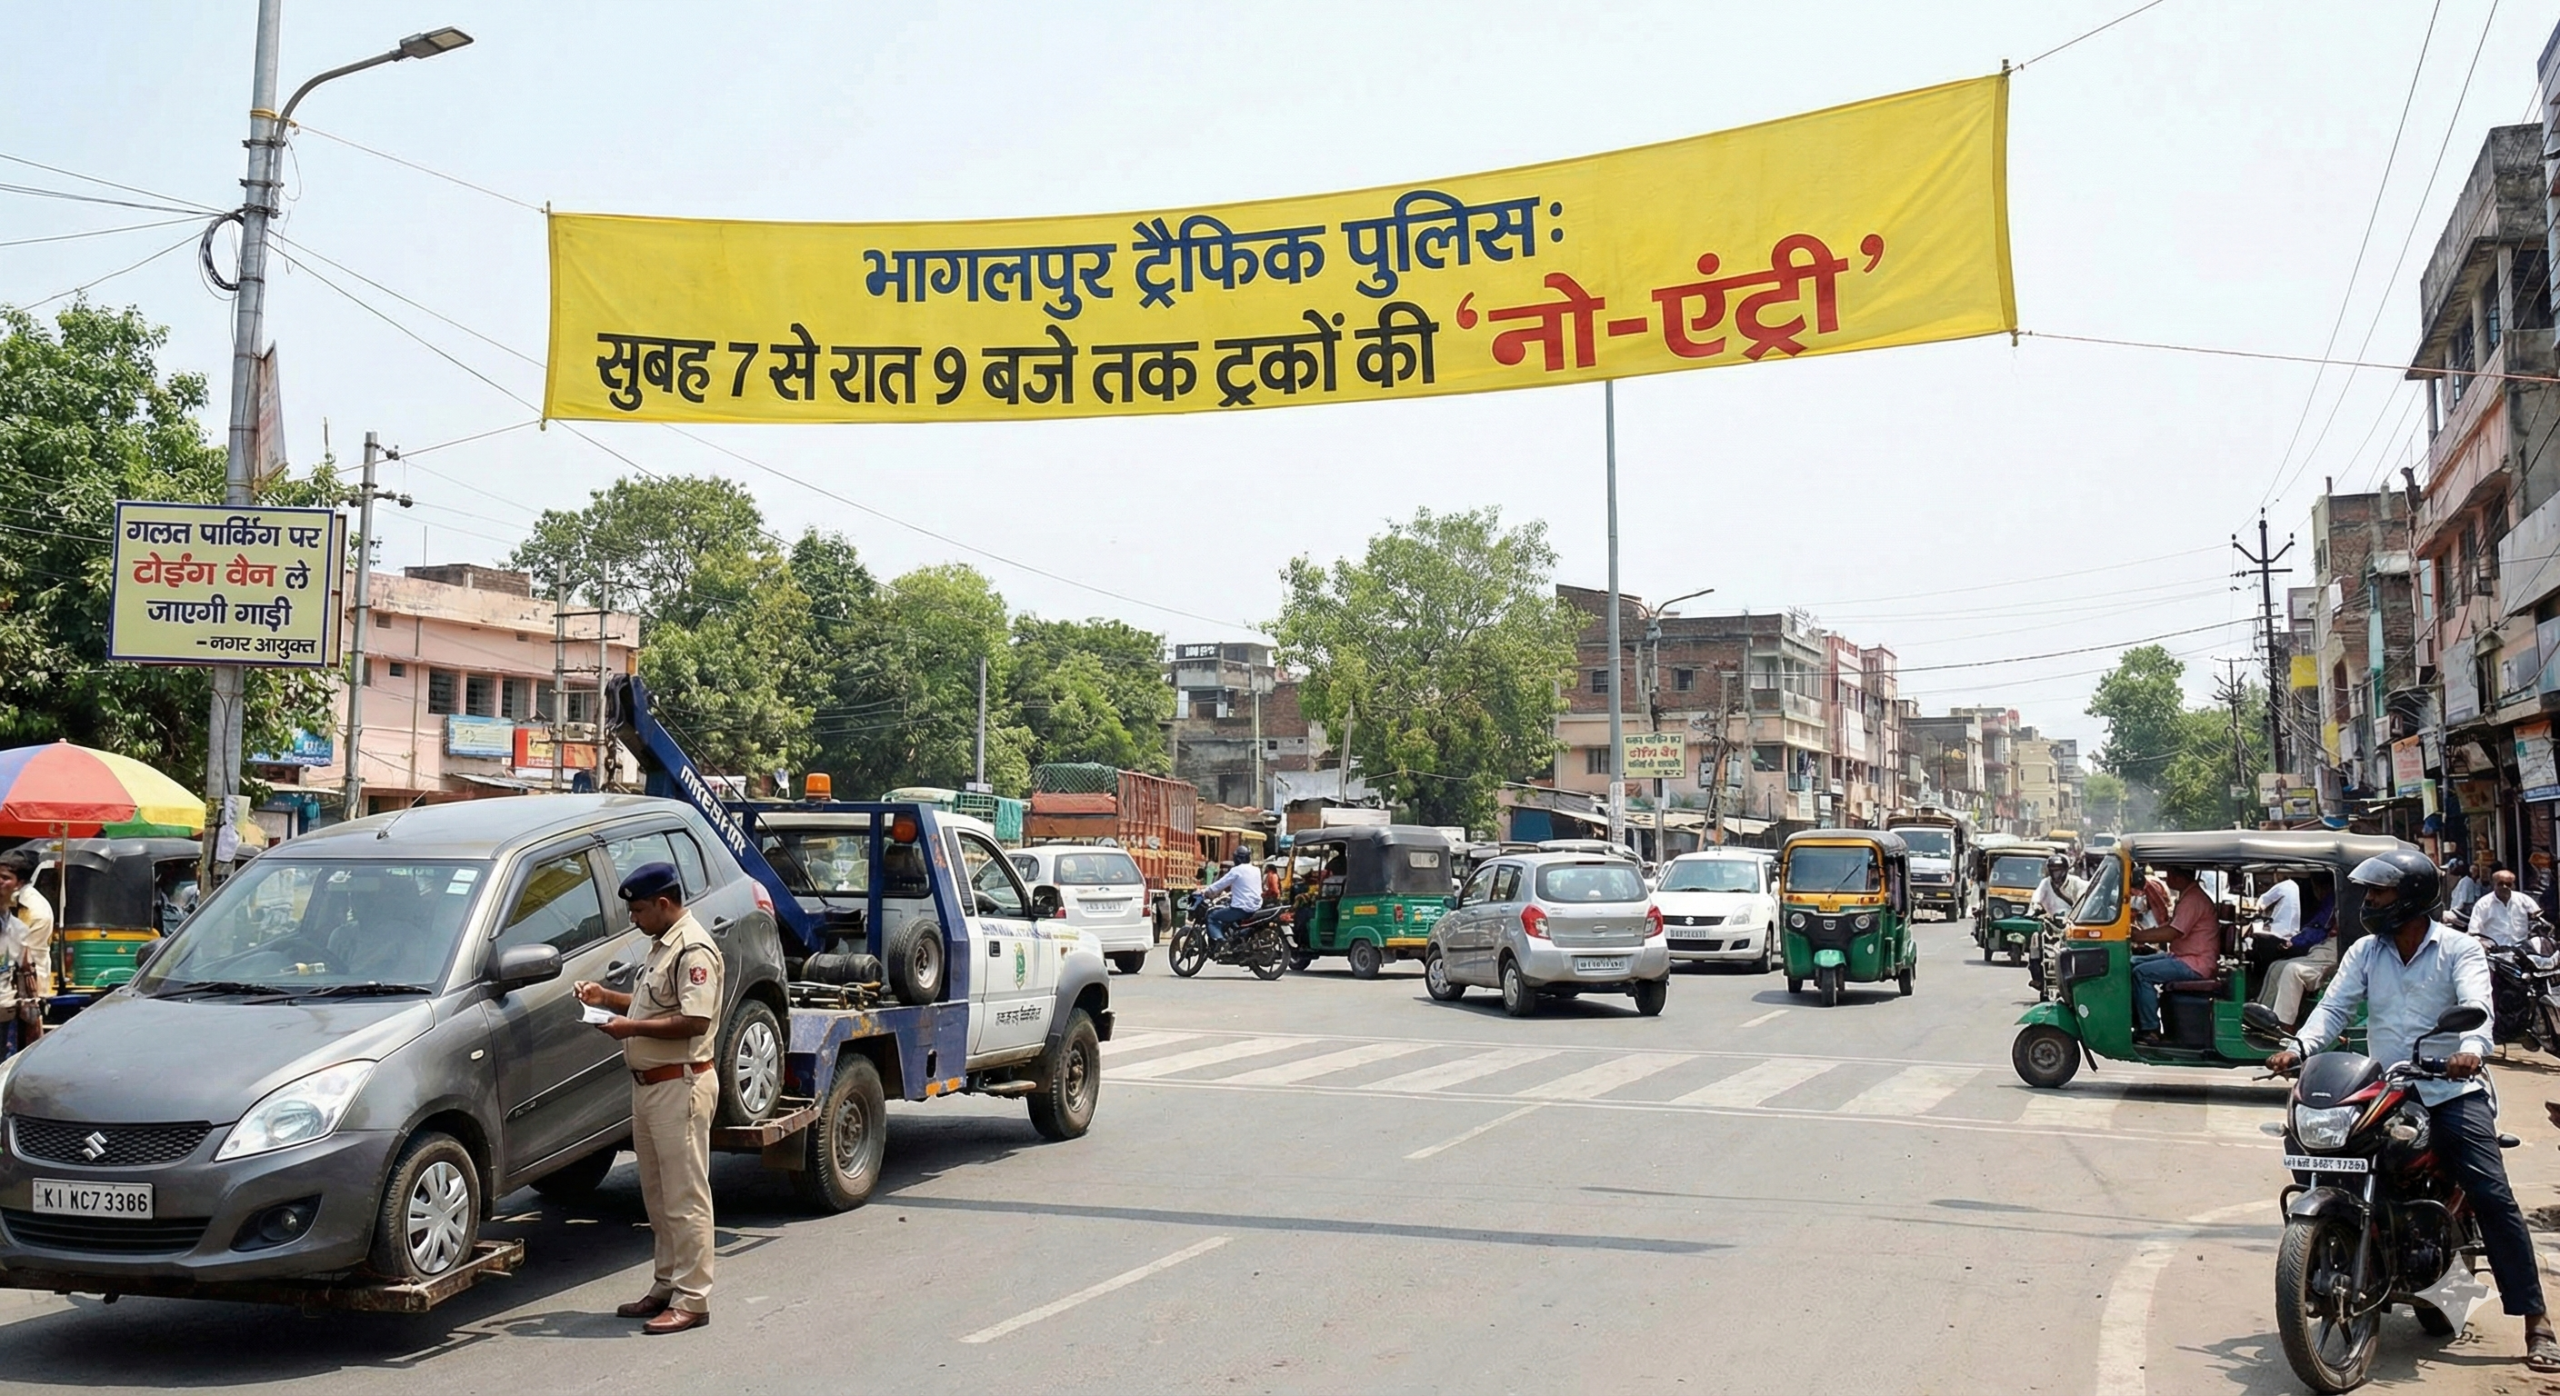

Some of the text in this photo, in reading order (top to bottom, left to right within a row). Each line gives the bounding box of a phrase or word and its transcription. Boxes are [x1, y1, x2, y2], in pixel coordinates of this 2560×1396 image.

[864, 244, 1116, 320] भागलपुर
[1133, 215, 1325, 308] ट्रैफिक
[597, 333, 715, 411] सुबह
[729, 342, 758, 397] 7
[769, 323, 820, 400] से
[831, 346, 921, 404] रात
[934, 347, 966, 404] 9
[982, 323, 1078, 405] बजे
[1092, 342, 1198, 403] तक
[1215, 310, 1344, 407] ट्रकों
[1355, 301, 1439, 388] की
[127, 516, 322, 548] गलत पार्किंग पर
[225, 553, 277, 587] वैन
[285, 560, 311, 589] ले
[147, 594, 292, 632] जाएगी गाड़ी
[254, 637, 317, 660] आयुक्त
